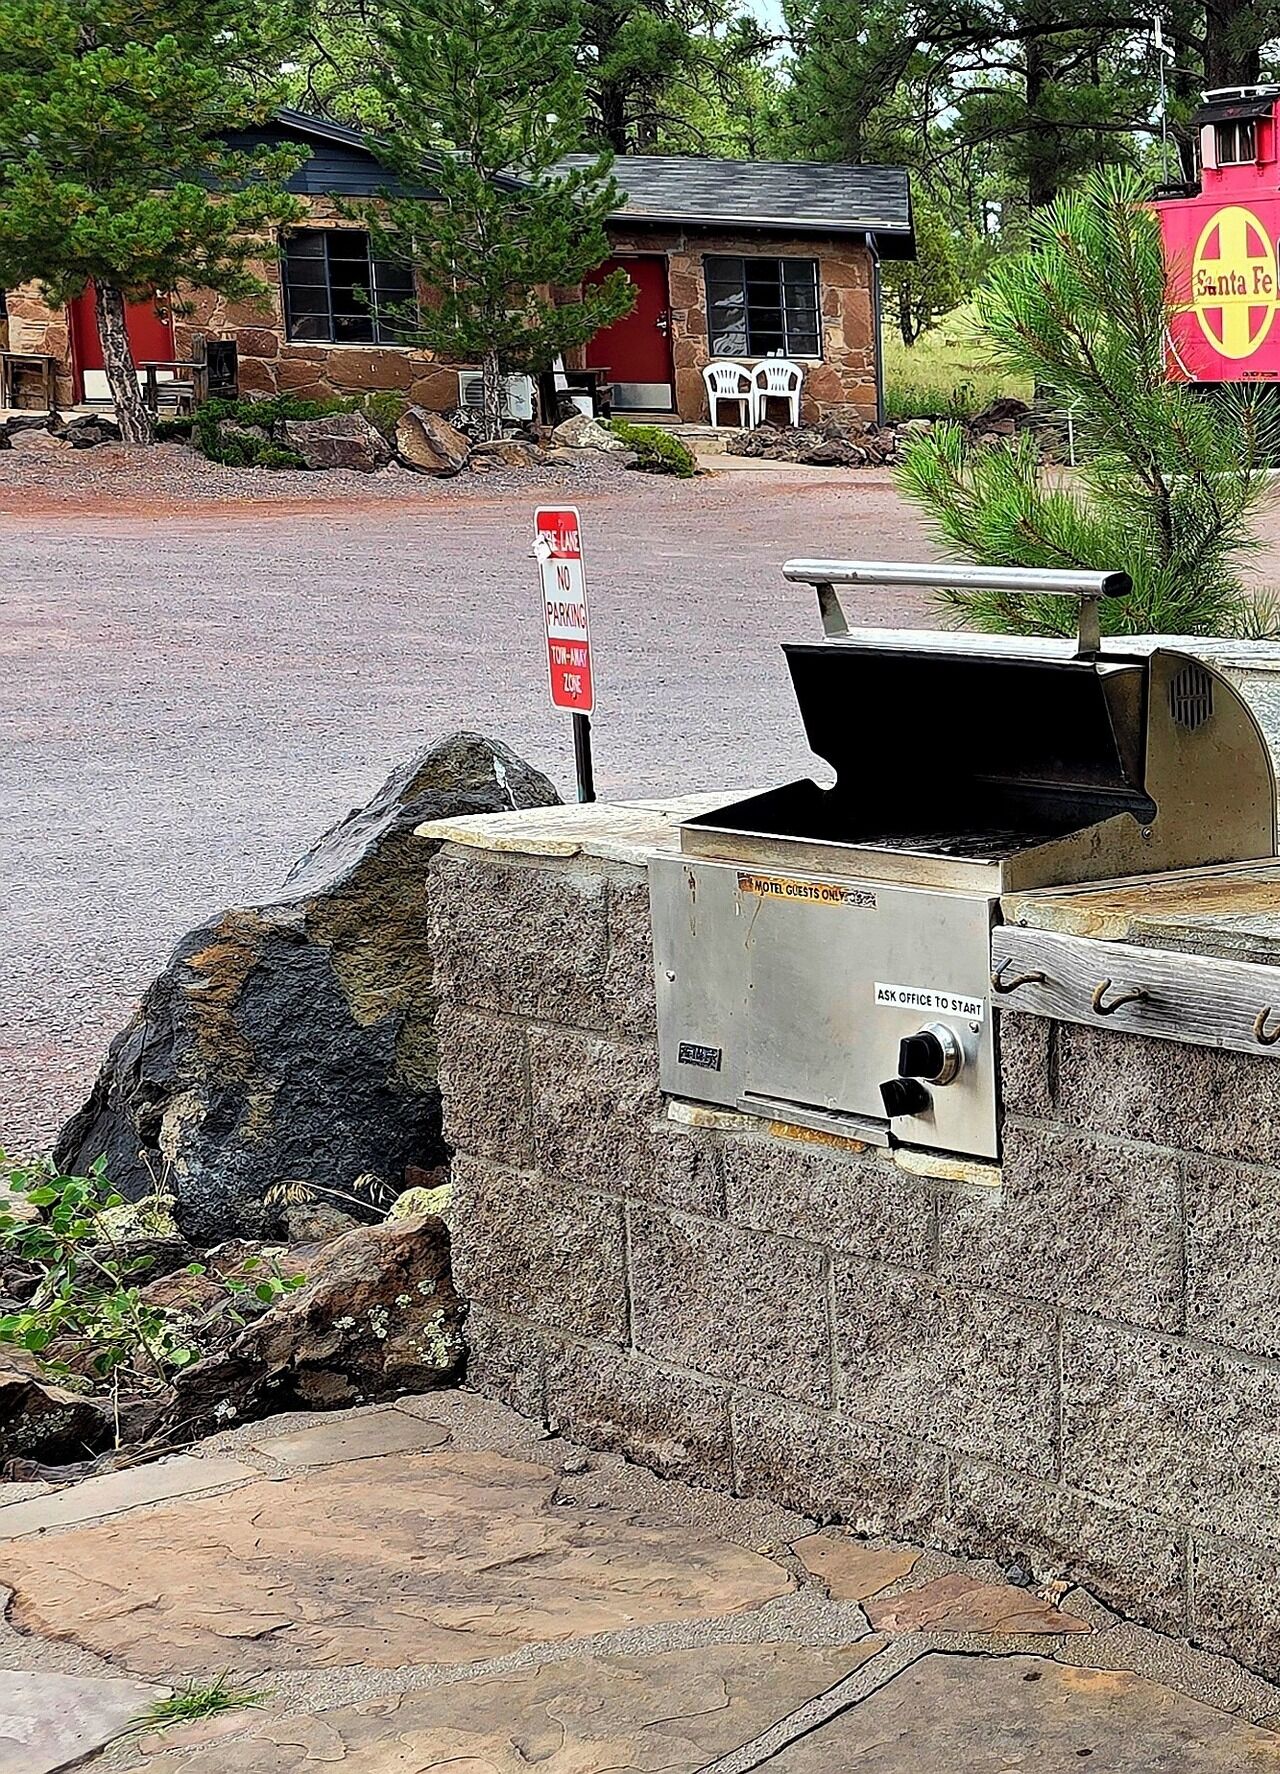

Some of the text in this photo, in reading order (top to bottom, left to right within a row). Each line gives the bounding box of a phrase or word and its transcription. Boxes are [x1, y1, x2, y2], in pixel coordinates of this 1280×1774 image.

[1197, 265, 1273, 296] Santa Fe
[560, 530, 580, 552] LANE
[556, 565, 571, 592] NO
[547, 601, 587, 630] PARKING
[550, 645, 588, 668] TOW-AWAY
[562, 672, 583, 694] ZONE
[755, 880, 784, 895] MOTEL
[785, 884, 820, 899] GUESTS
[821, 888, 847, 902] ONLY
[878, 989, 982, 1016] ASK OFFICE TO START
